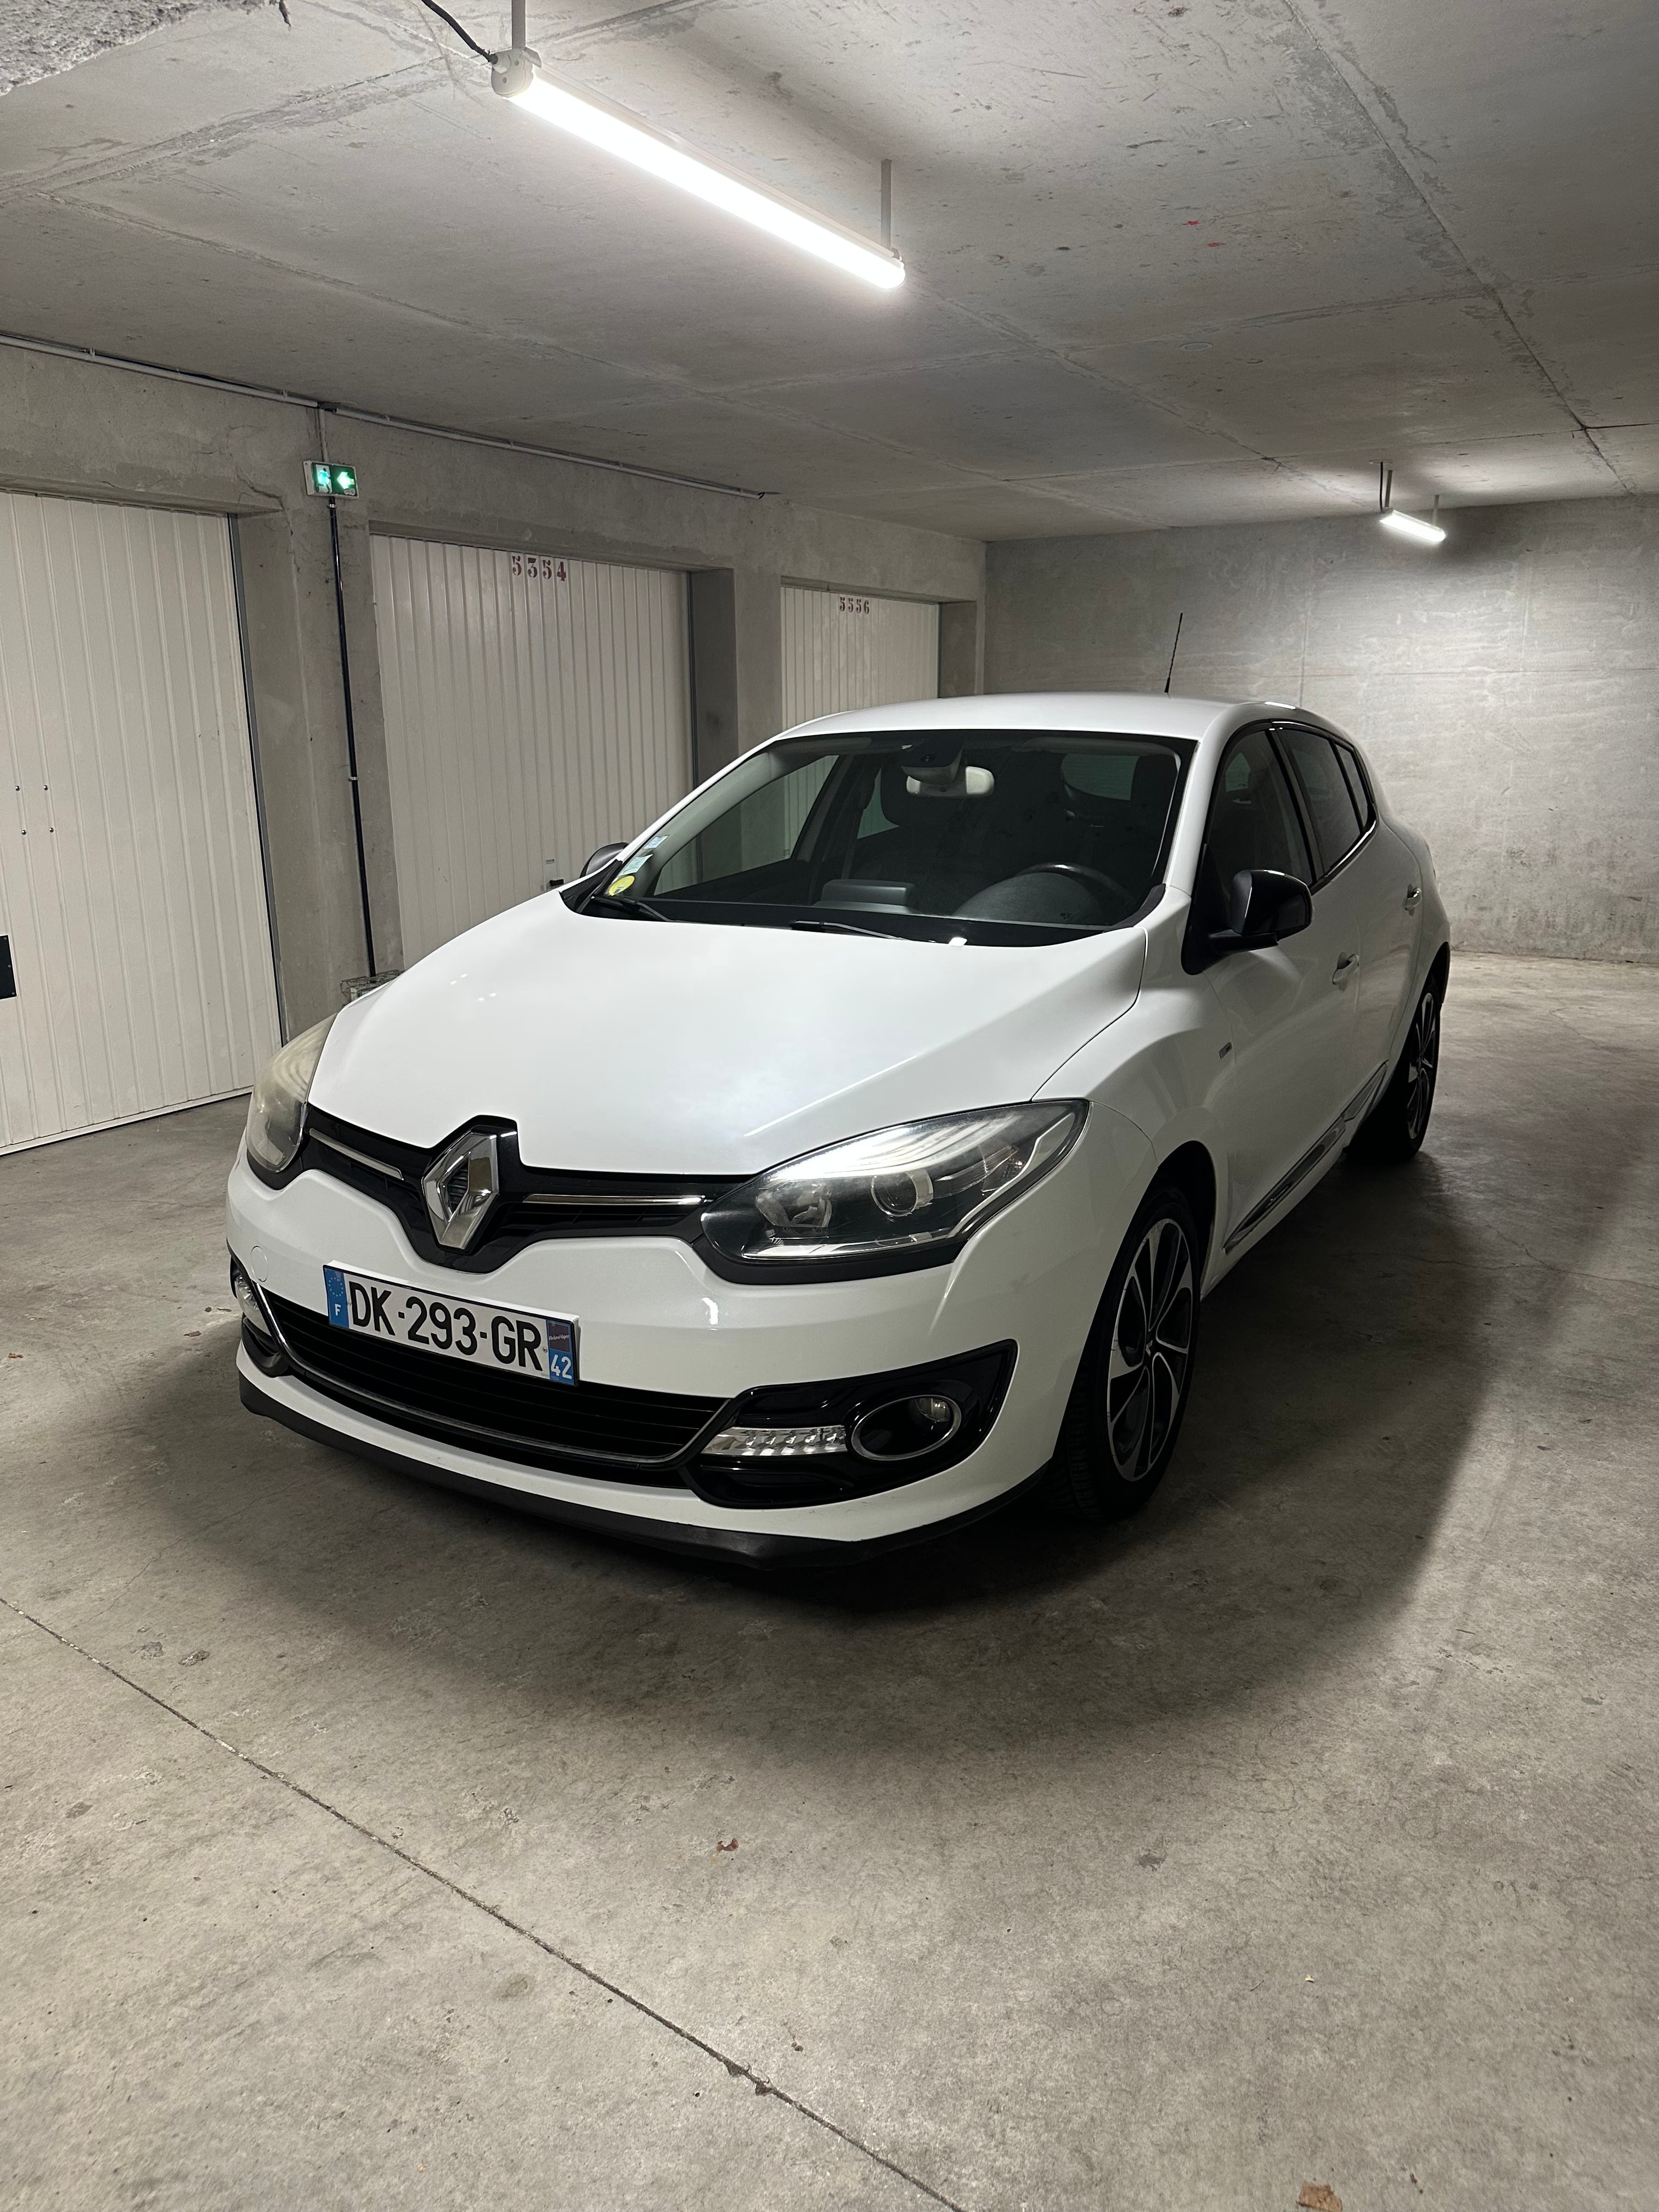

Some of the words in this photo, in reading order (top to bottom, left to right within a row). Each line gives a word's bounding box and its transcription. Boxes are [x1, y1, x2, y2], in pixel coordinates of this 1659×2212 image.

[335, 1303, 341, 1316] F
[348, 1280, 543, 1372] DK-293-GR
[551, 1355, 572, 1379] 42
